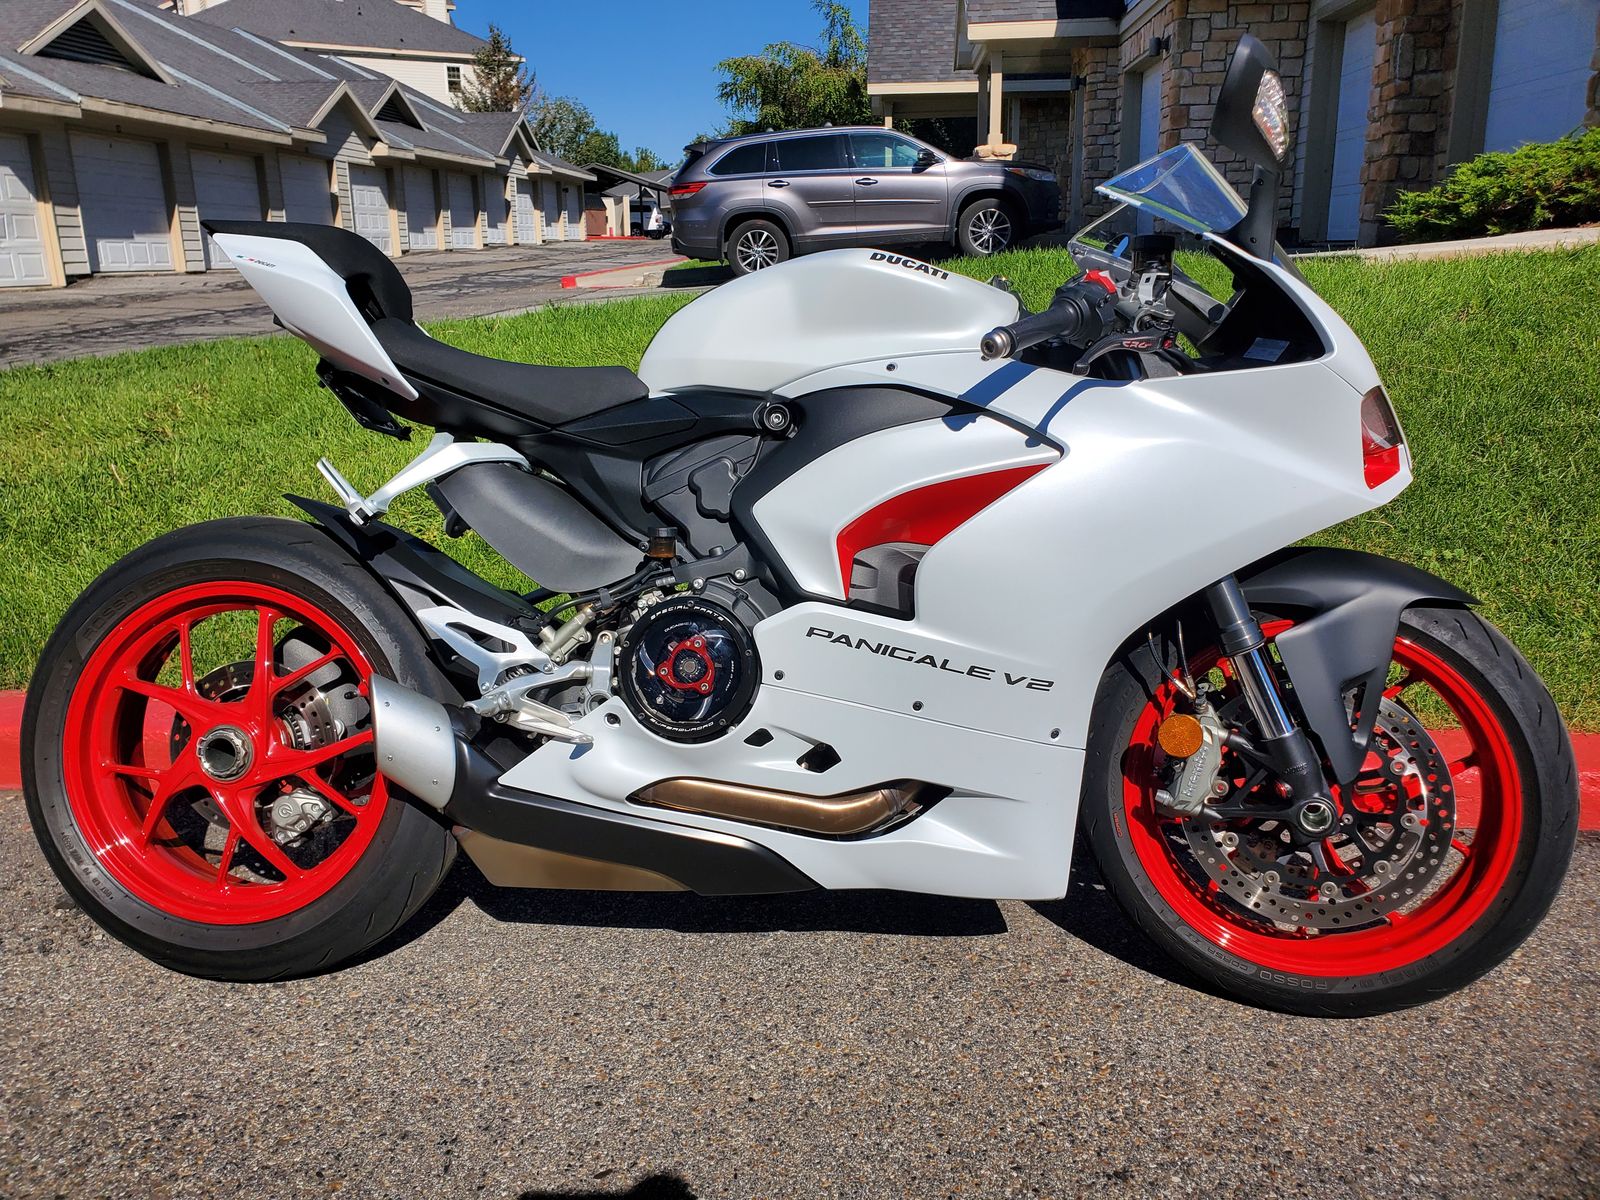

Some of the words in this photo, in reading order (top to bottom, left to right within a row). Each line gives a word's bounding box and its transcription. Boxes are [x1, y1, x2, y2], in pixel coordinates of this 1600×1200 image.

[869, 252, 949, 280] DUCATI
[650, 605, 689, 620] SPECIAL
[693, 606, 724, 621] PARTS
[806, 626, 996, 680] PANIGALE
[1004, 672, 1055, 692] V2
[650, 718, 714, 732] SUPERQUADRO
[1207, 946, 1248, 971] CORSA
[1259, 969, 1328, 990] ROSSO
